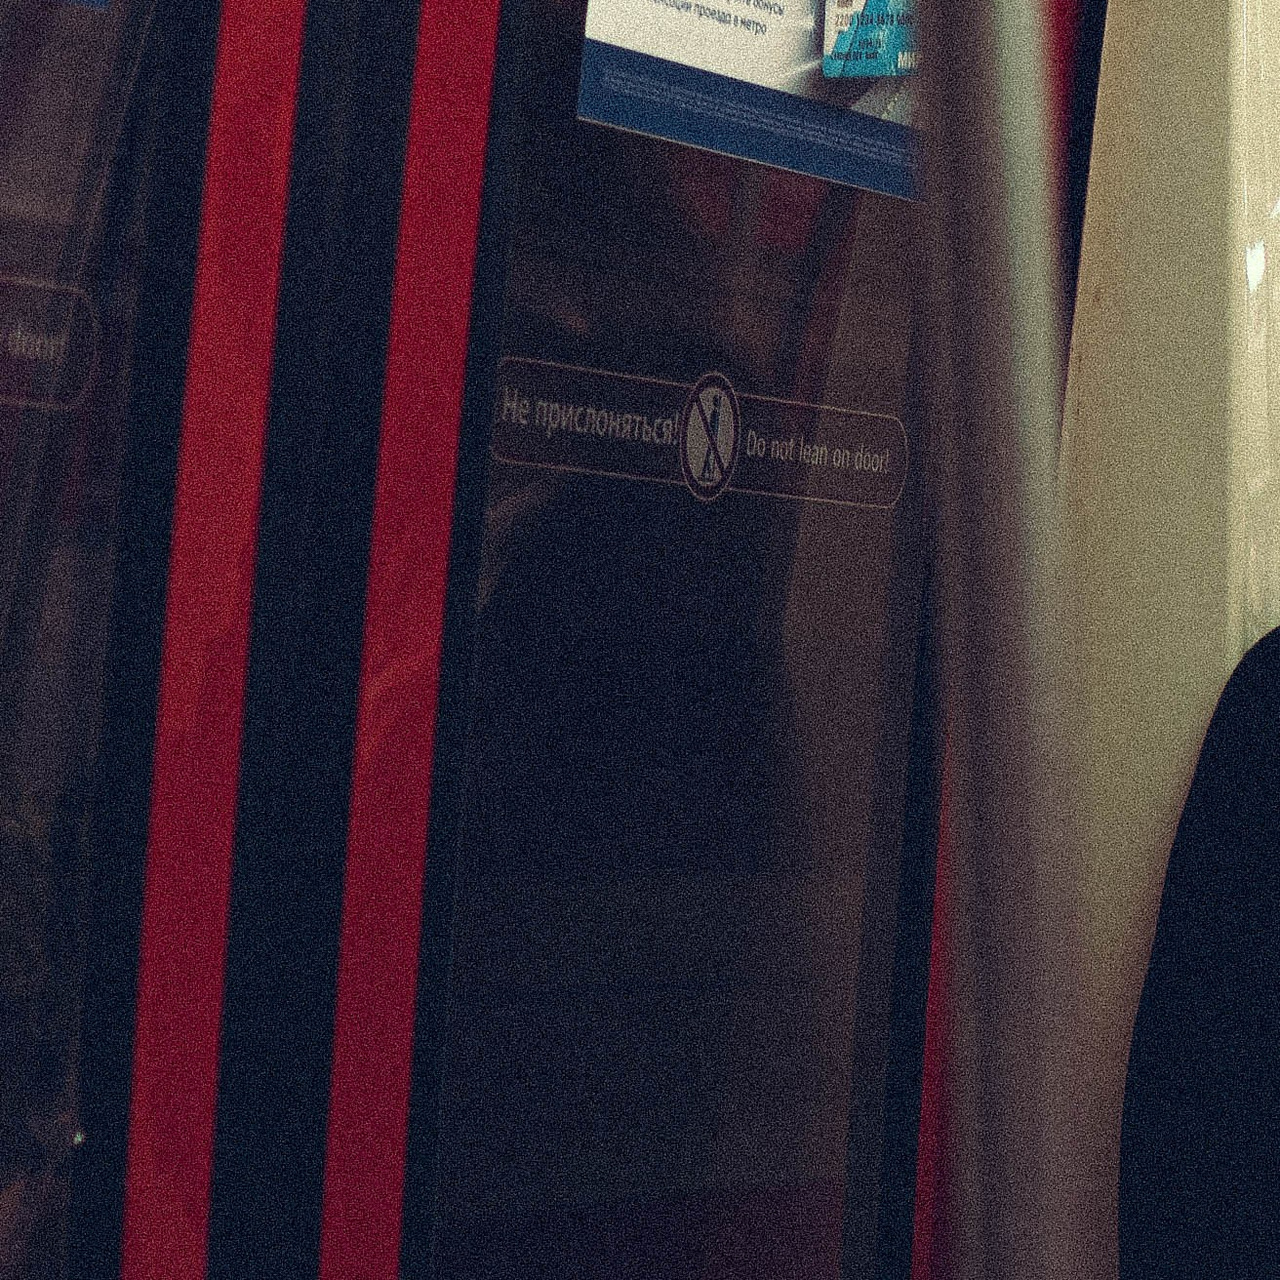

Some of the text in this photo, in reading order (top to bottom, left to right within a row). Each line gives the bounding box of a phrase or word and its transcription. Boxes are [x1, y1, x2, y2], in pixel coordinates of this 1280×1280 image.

[694, 3, 732, 25] проезда
[740, 17, 768, 36] метро
[502, 385, 679, 446] Не прислоняться!
[746, 429, 767, 458] Do
[770, 437, 795, 462] not
[800, 435, 829, 466] lean
[832, 448, 851, 469] on
